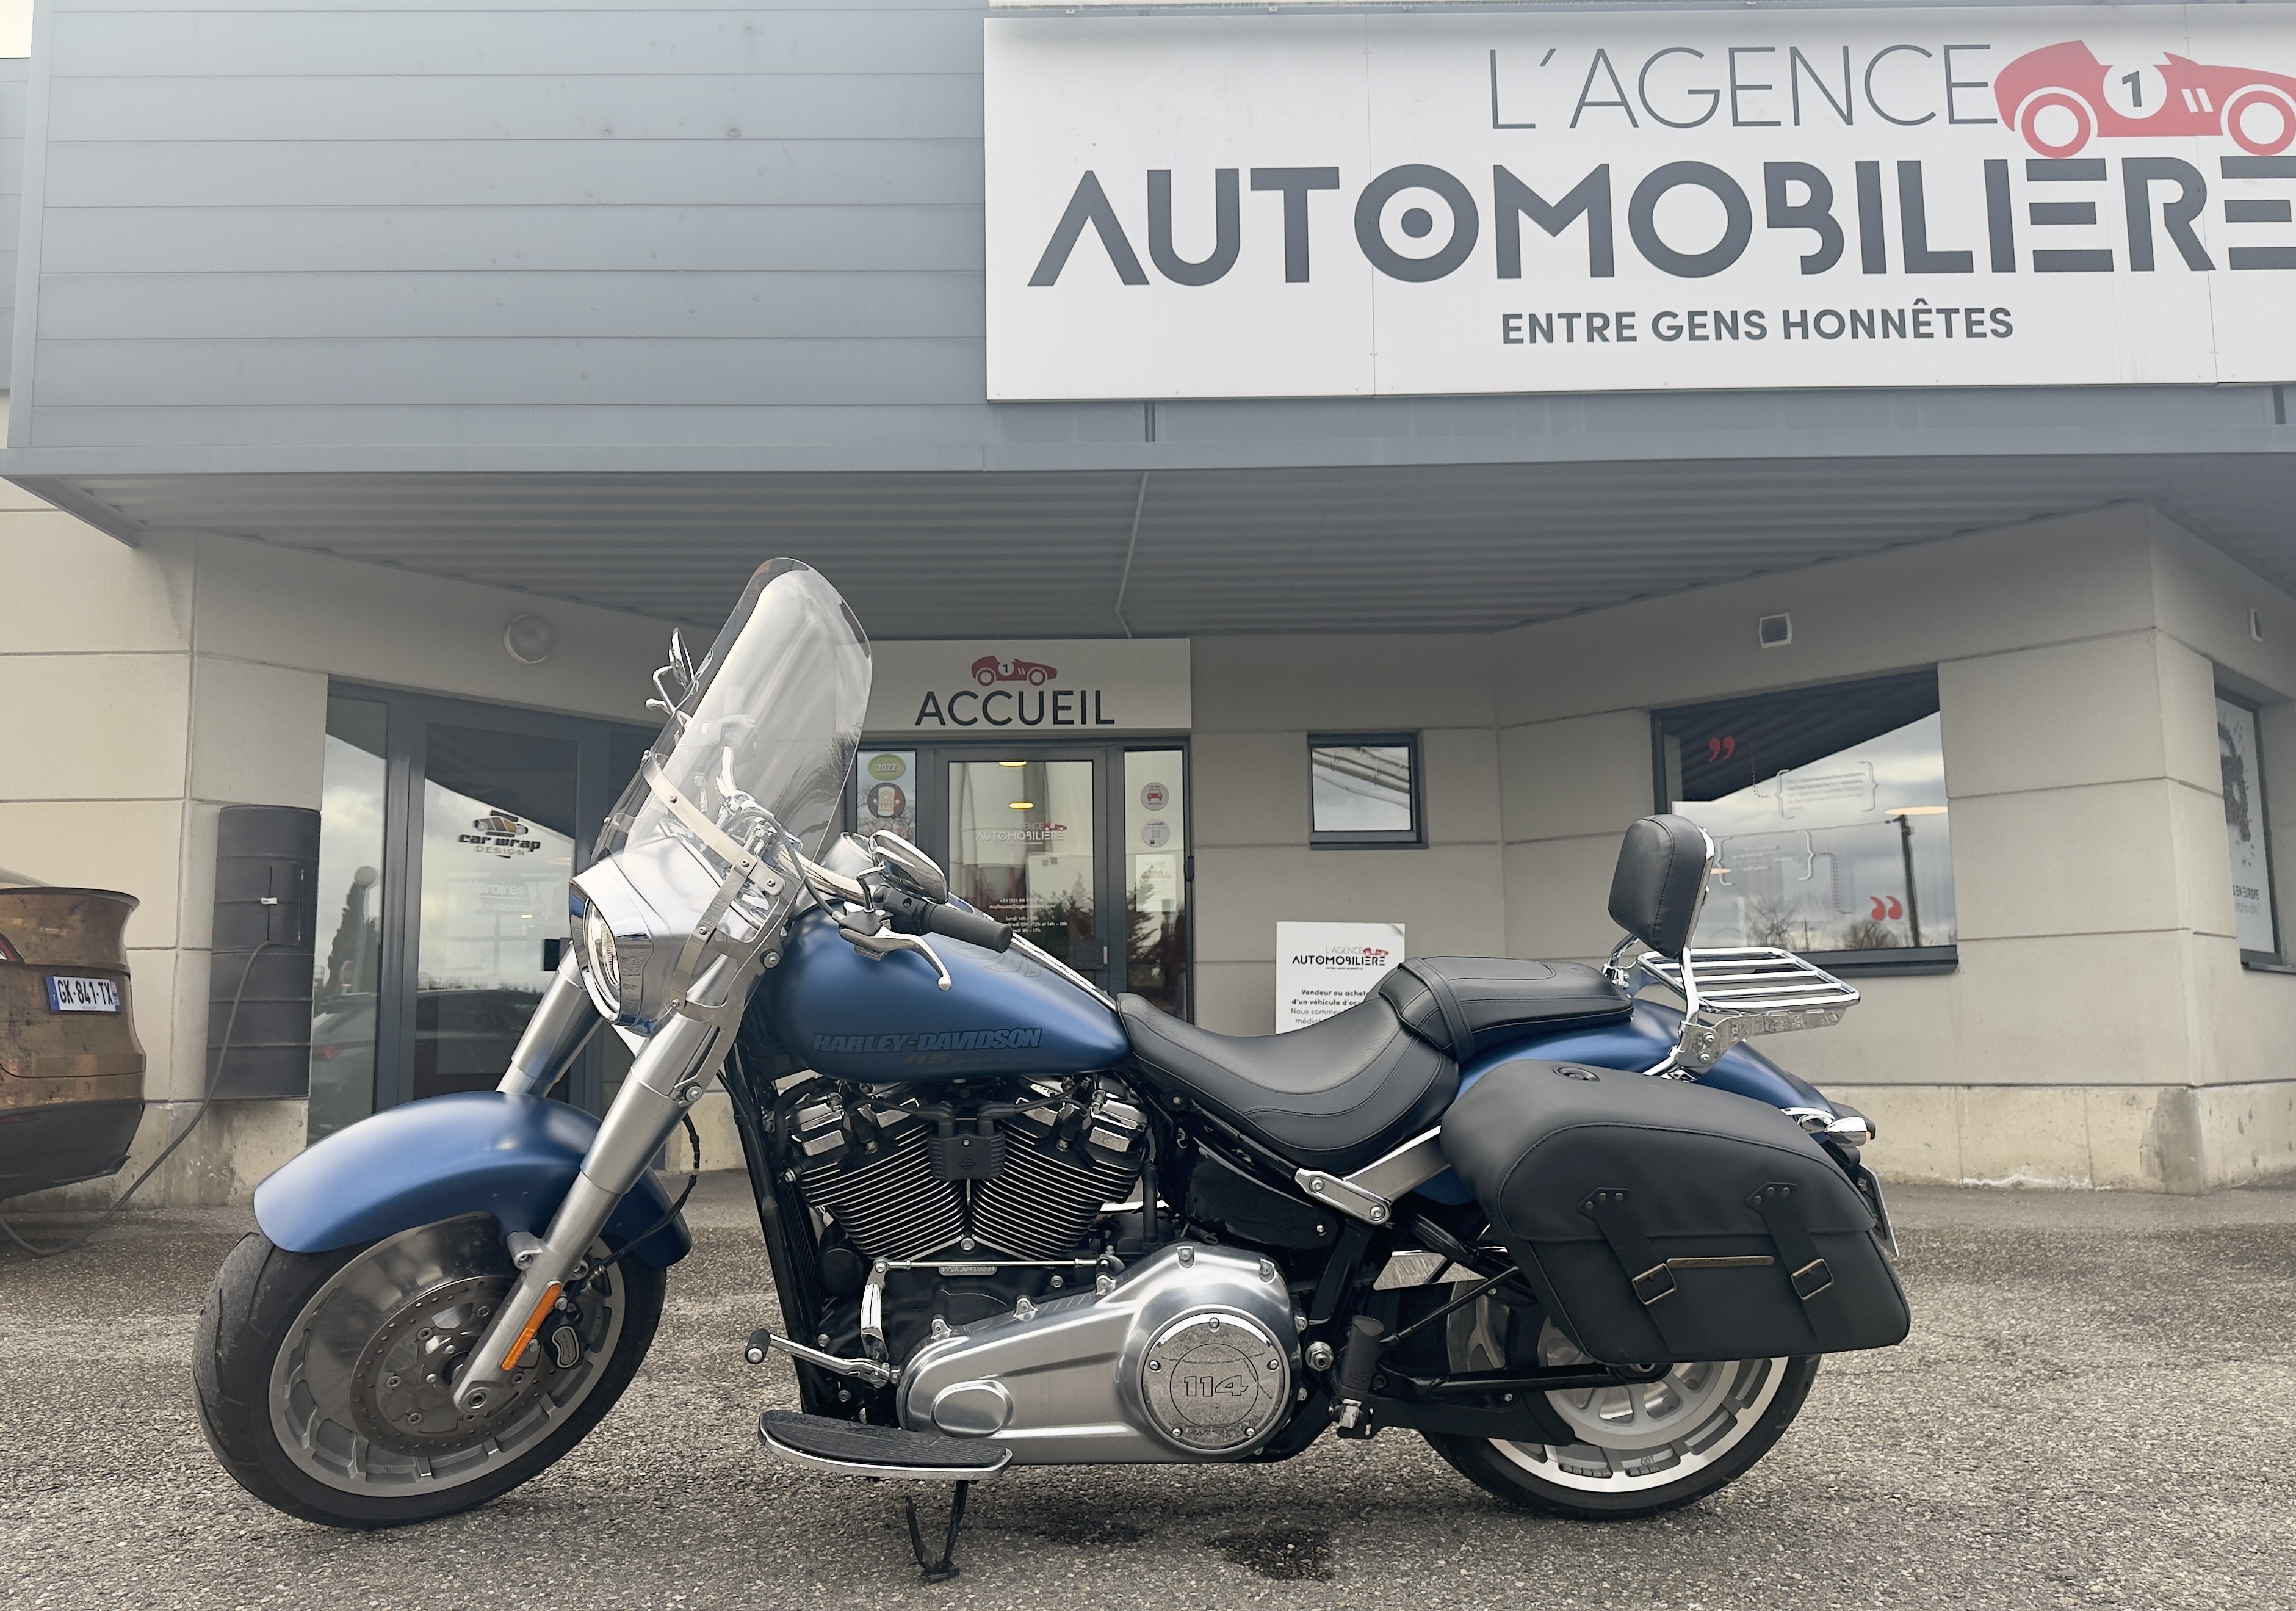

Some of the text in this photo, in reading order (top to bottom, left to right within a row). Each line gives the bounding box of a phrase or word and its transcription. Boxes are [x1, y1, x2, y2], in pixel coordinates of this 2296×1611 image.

[2122, 71, 2142, 107] 1
[1503, 298, 2013, 344] ENTRE GENS HONNÊTES
[915, 690, 1115, 726] ACCUEIL
[876, 763, 897, 772] 2022
[459, 834, 541, 852] car wrap
[475, 845, 525, 855] DESIGN
[471, 881, 525, 896] oraires
[57, 980, 114, 1005] GK-841-TX
[812, 1028, 1042, 1052] HARLEY-DAVIDSON
[1184, 1375, 1249, 1397] 114
